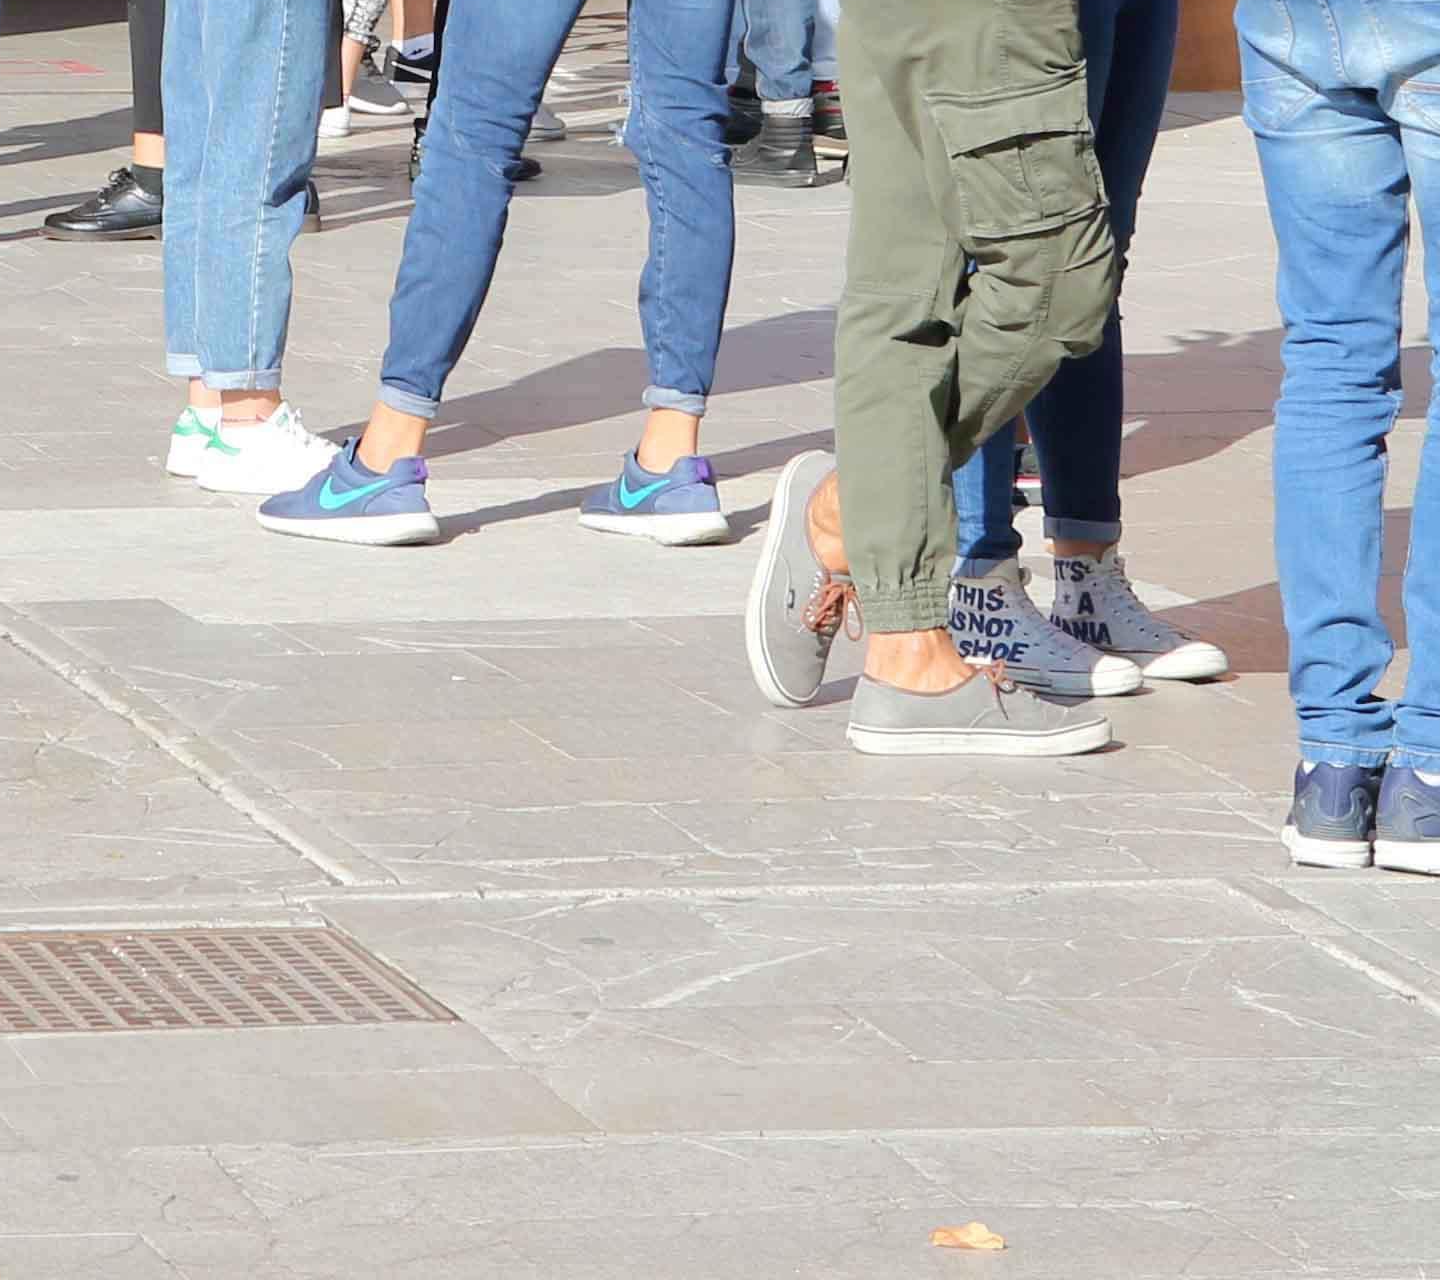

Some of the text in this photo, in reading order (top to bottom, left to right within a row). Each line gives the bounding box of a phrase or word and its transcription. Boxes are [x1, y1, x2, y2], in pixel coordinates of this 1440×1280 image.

[955, 583, 1004, 611] THIS
[1077, 591, 1094, 614] A
[958, 639, 1029, 662] SHOE
